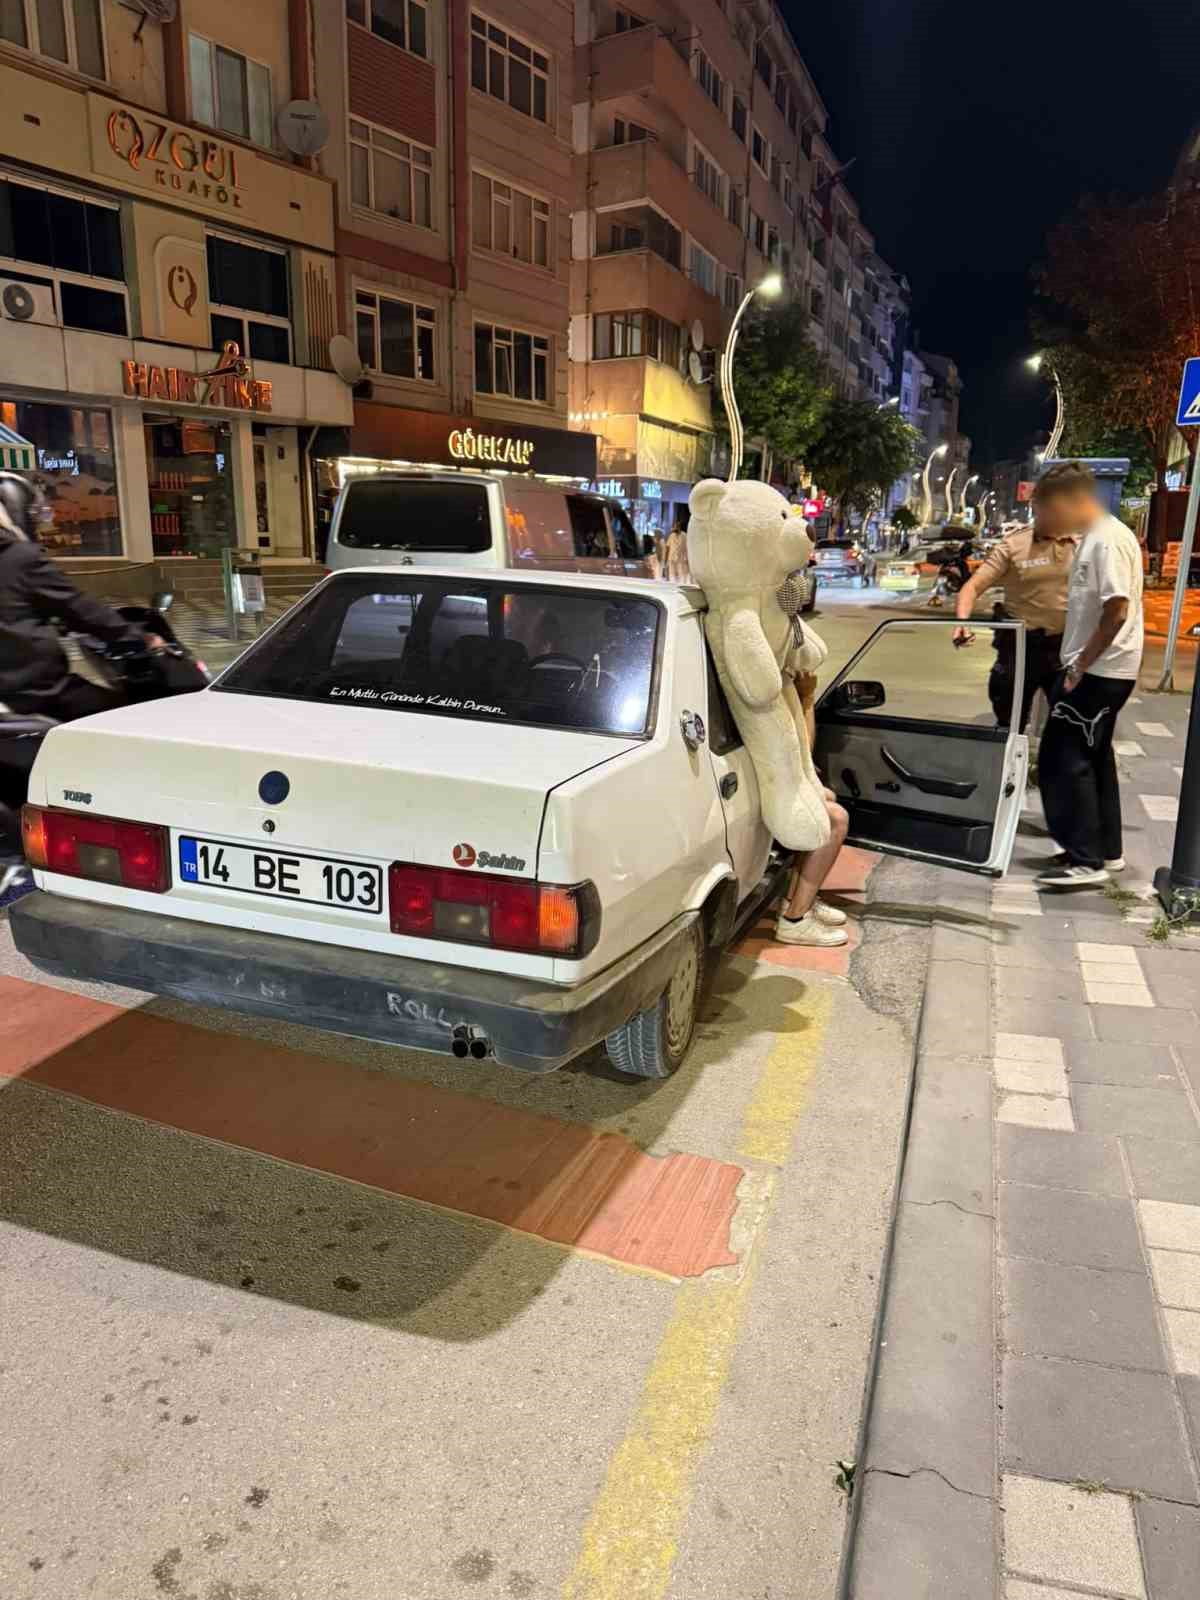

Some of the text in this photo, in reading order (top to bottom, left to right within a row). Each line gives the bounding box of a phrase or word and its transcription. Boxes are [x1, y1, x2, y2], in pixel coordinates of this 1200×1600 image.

[347, 687, 379, 700] Mutlu
[183, 861, 197, 873] TR
[199, 845, 376, 906] 14 BE 103
